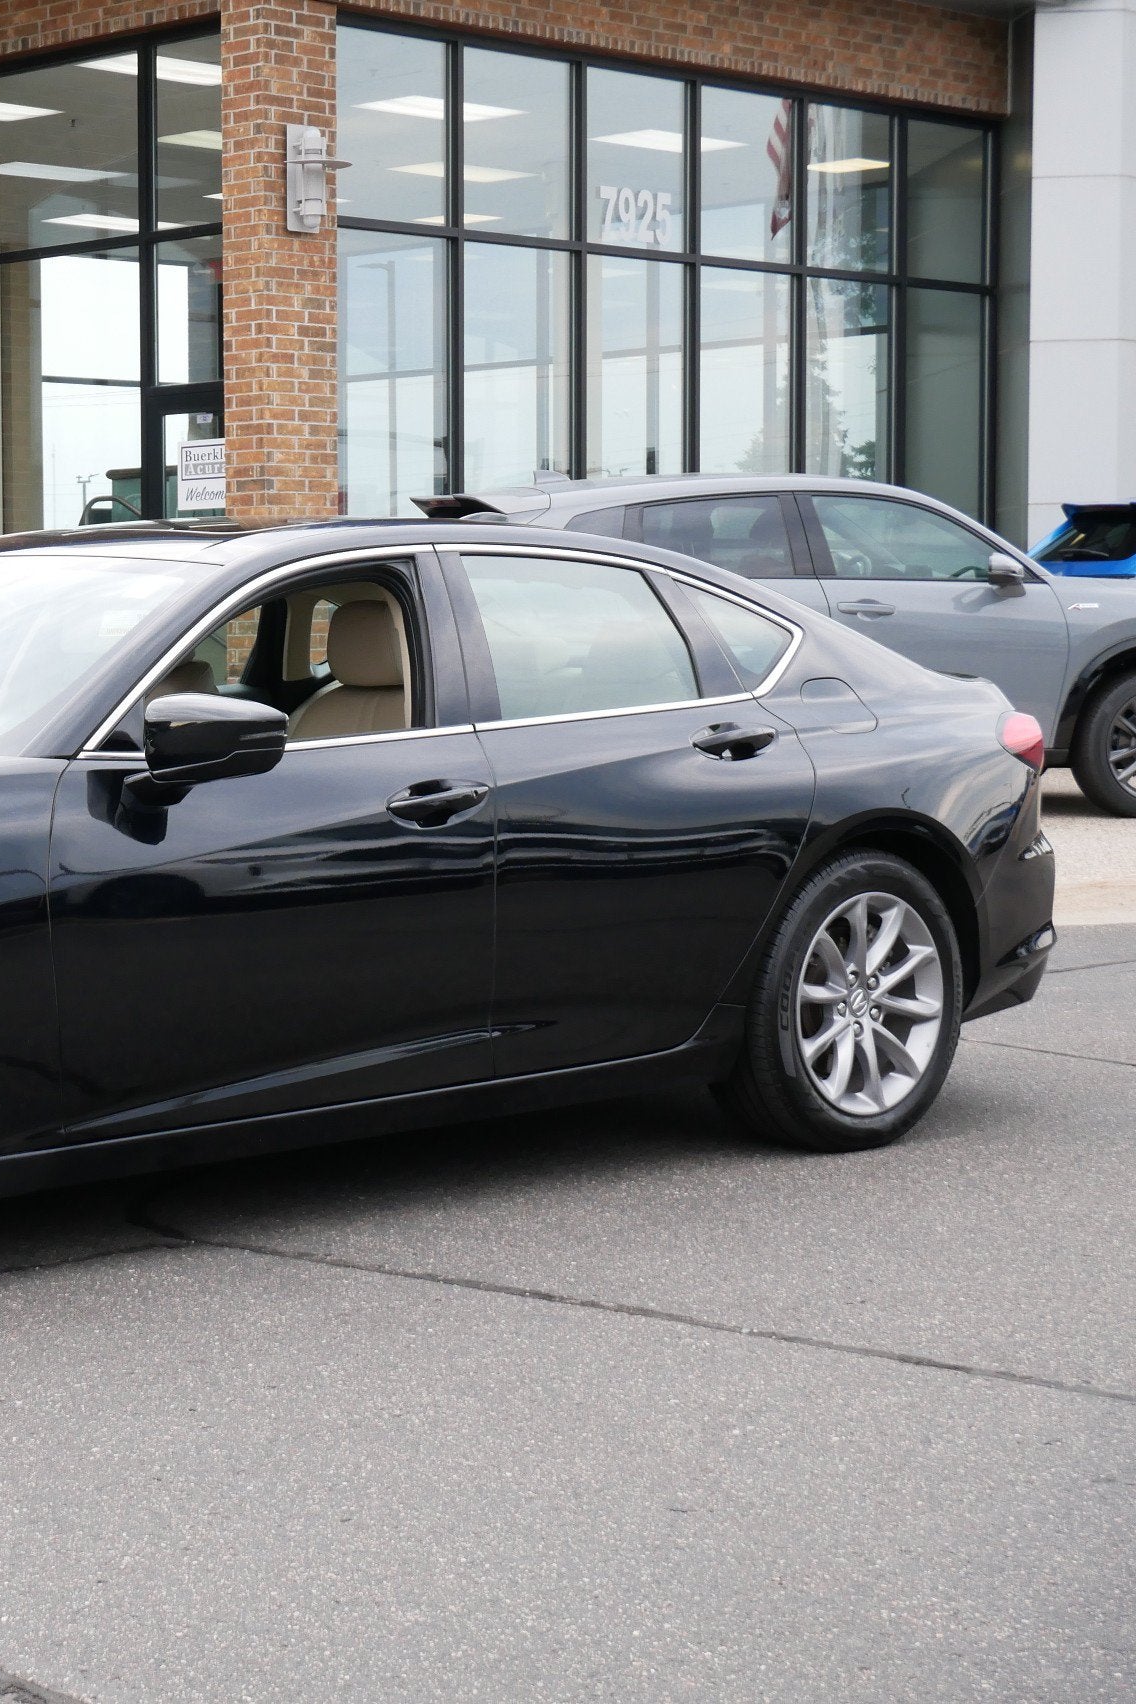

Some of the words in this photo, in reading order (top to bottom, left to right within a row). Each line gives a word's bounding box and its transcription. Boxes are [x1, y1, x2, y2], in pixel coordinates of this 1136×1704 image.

[599, 185, 672, 245] 7925
[185, 448, 224, 462] Buerkl
[185, 486, 226, 502] Welcom
